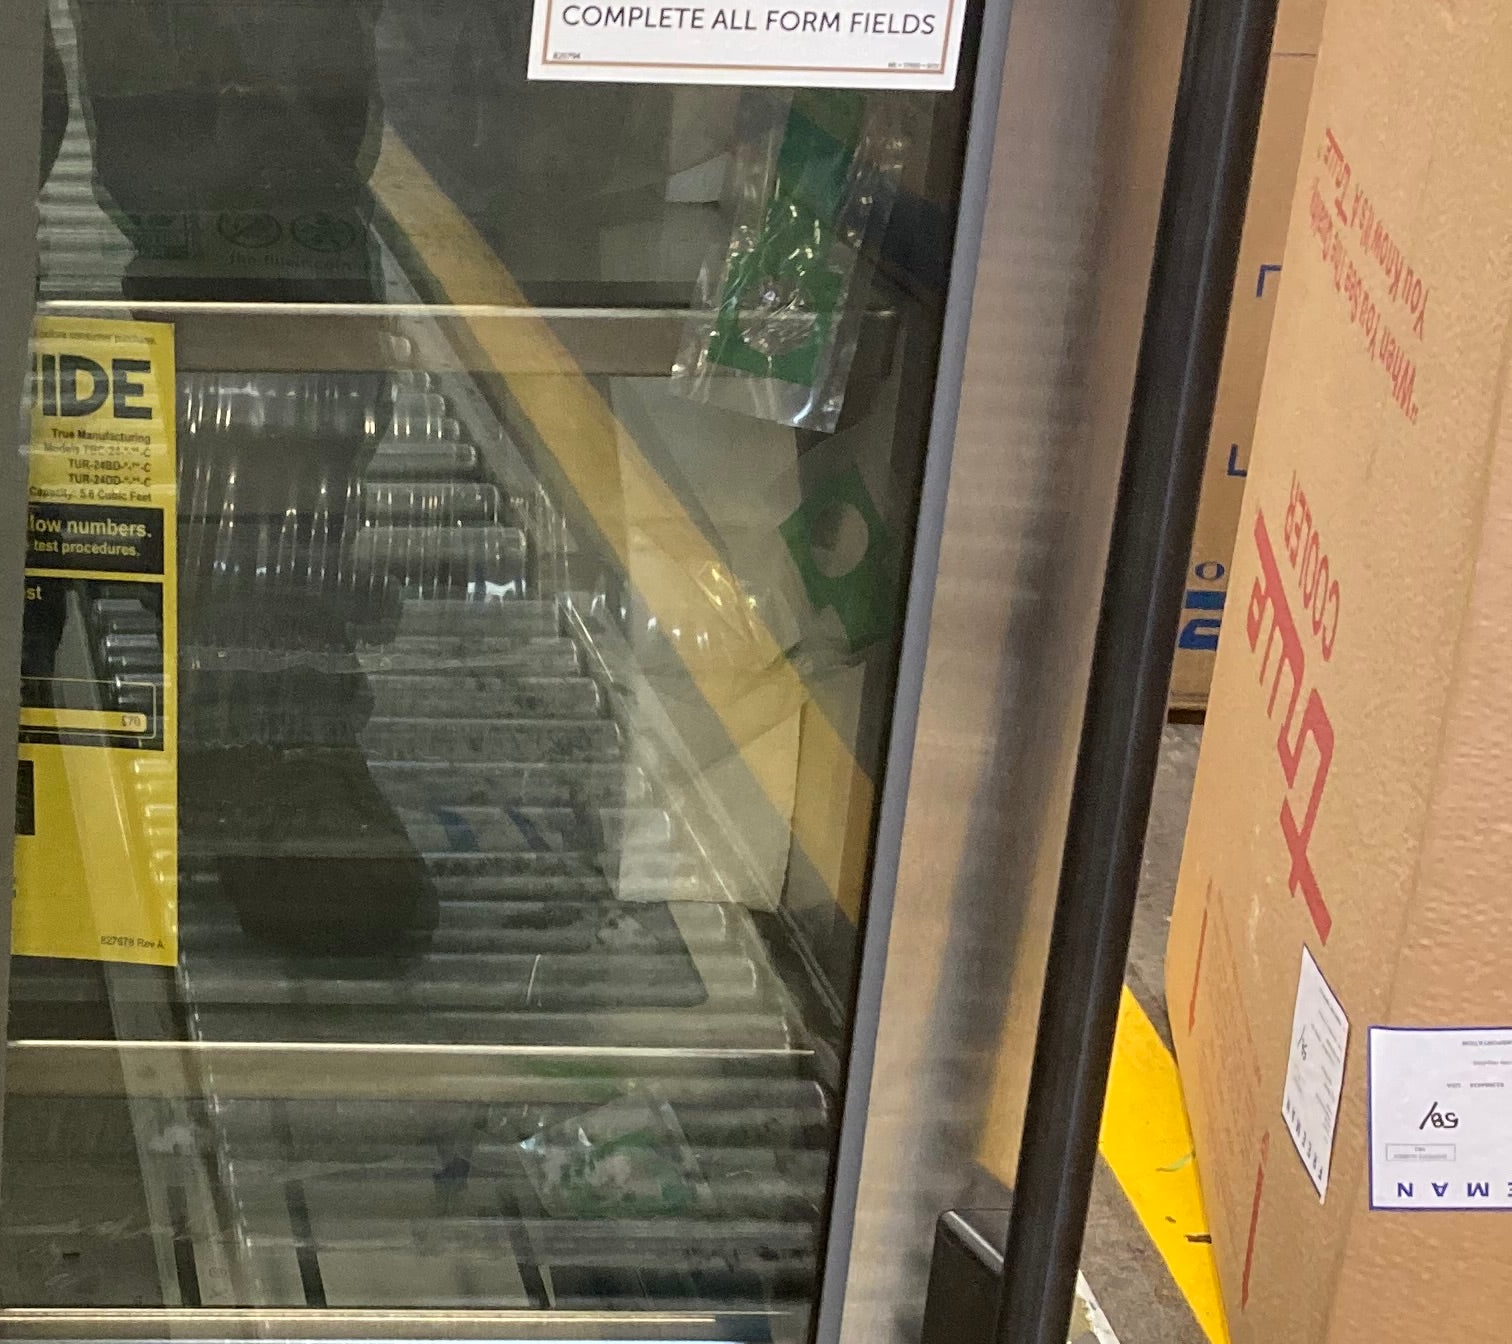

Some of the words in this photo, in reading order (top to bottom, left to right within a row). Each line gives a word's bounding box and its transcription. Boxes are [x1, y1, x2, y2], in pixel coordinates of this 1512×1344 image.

[562, 5, 705, 30] COMPLETE
[711, 8, 757, 31] ALL
[766, 10, 841, 33] FORM
[849, 12, 936, 36] FIELDS
[51, 428, 75, 439] True
[77, 430, 151, 444] Manufacturing
[130, 490, 152, 502] Feet
[67, 518, 153, 538] numbers.
[33, 539, 58, 552] test
[1284, 469, 1341, 662] COOLER
